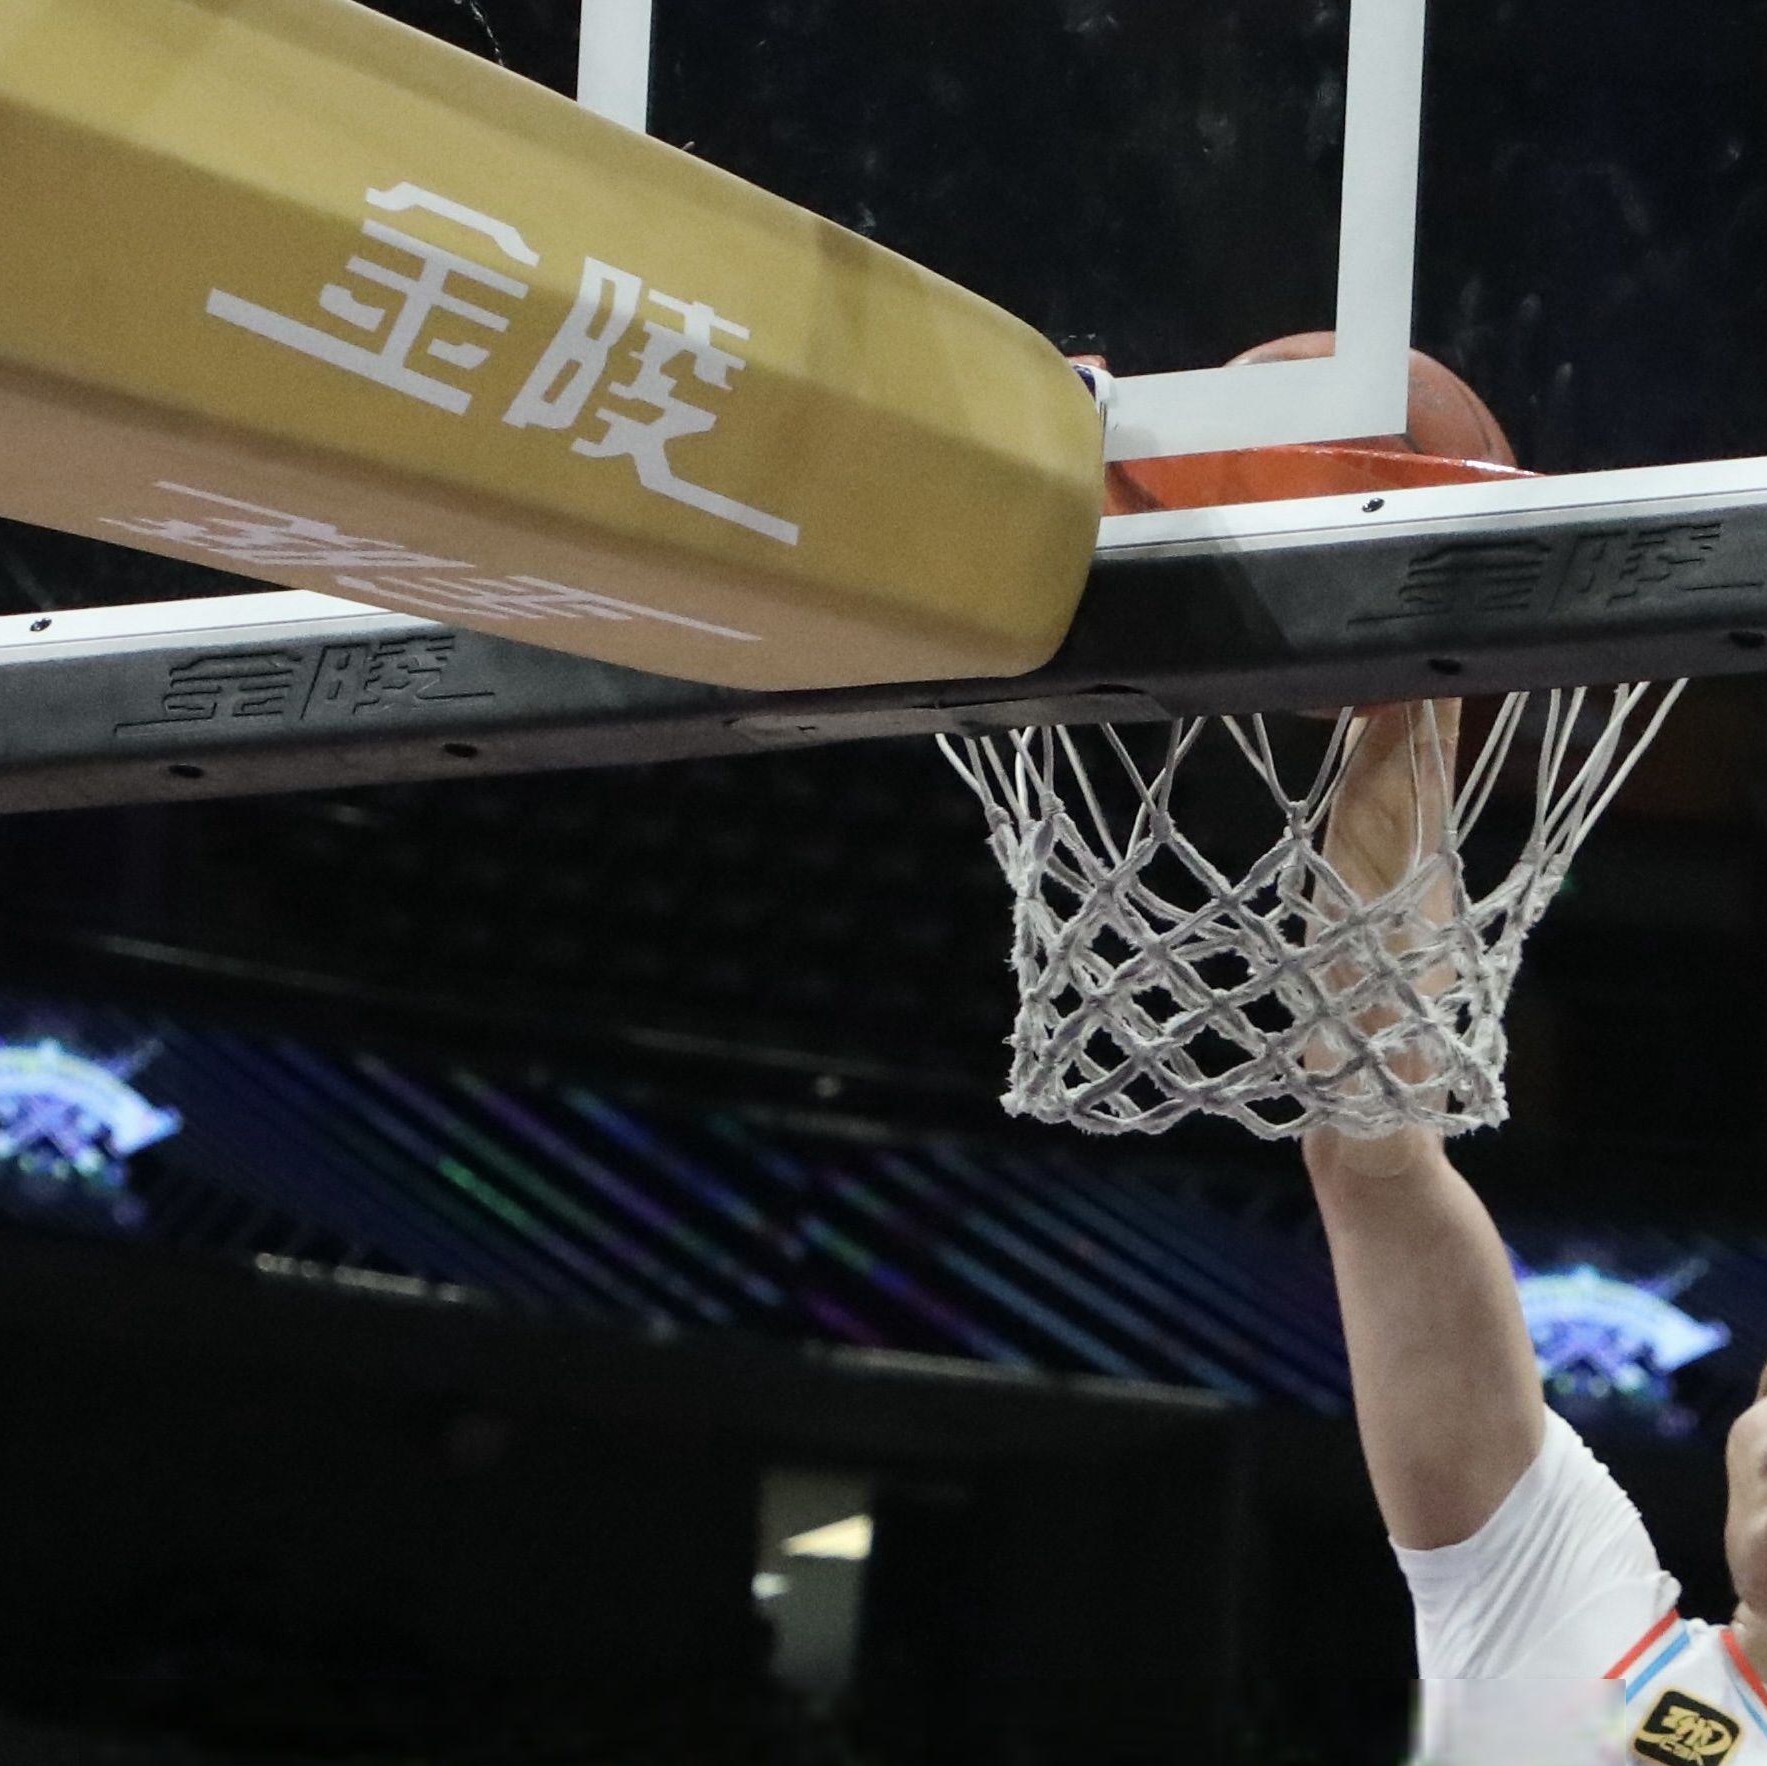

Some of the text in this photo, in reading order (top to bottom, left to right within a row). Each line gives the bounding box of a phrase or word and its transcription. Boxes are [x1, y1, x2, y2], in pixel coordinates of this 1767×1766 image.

[206, 181, 798, 545] 金陵
[1347, 522, 1764, 632] 金陵
[113, 634, 496, 736] 金陵
